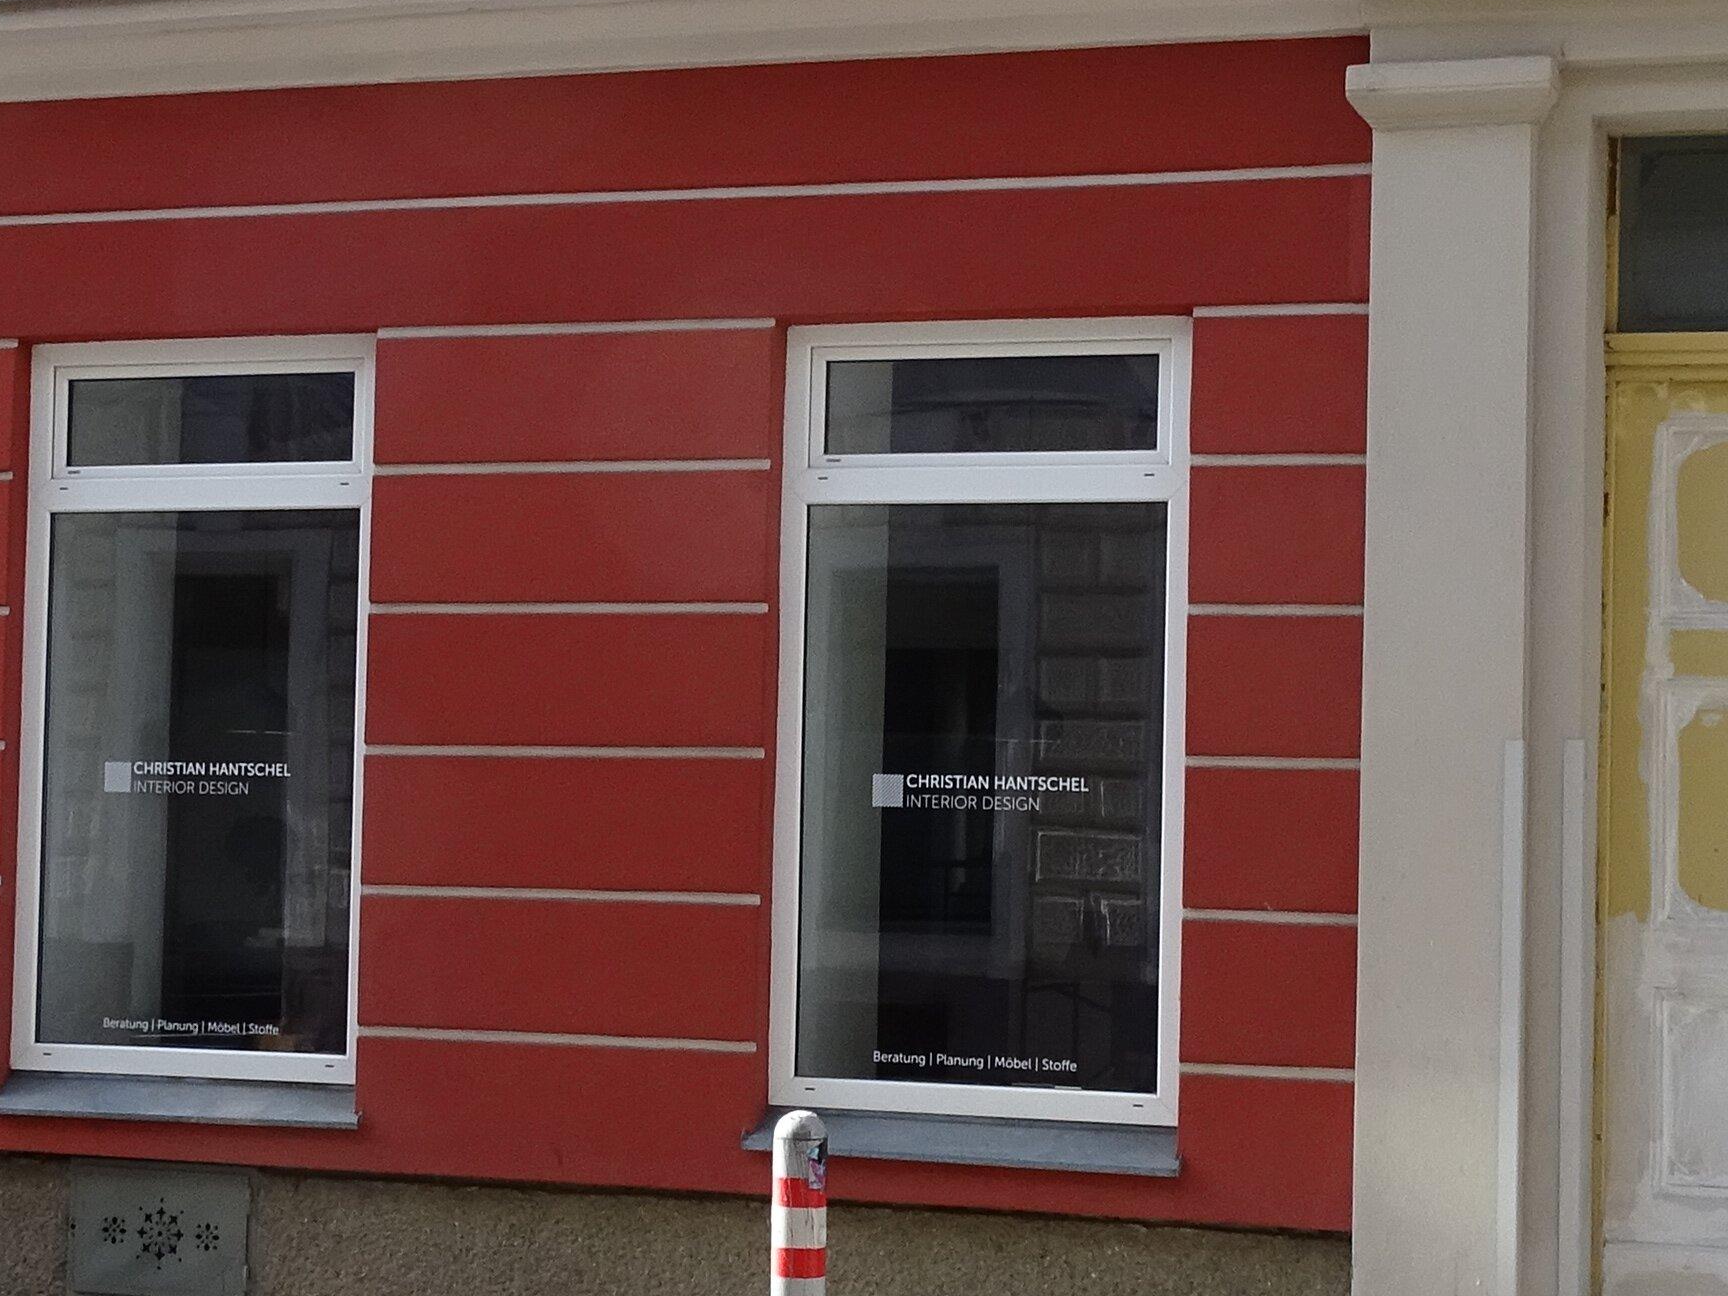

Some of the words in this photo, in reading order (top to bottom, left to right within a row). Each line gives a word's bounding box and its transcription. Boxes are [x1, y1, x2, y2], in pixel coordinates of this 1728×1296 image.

[133, 760, 206, 777] CHRISTIAN
[209, 761, 292, 778] HANTSCHEL
[133, 780, 196, 795] INTERIOR
[199, 780, 250, 796] DESIGN
[905, 773, 990, 791] CHRISTIAN
[994, 775, 1090, 793] HANTSCHEL
[905, 793, 978, 810] INTERIOR
[982, 794, 1041, 812] DESIGN
[102, 1016, 149, 1033] Beratung
[157, 1018, 199, 1036] Planung
[207, 1020, 242, 1035] Möbel
[248, 1022, 280, 1036] Stoffe
[872, 1050, 926, 1067] Beratung
[936, 1052, 984, 1070] Planung
[994, 1055, 1032, 1071] Möbel
[1042, 1058, 1078, 1073] Stoffe
